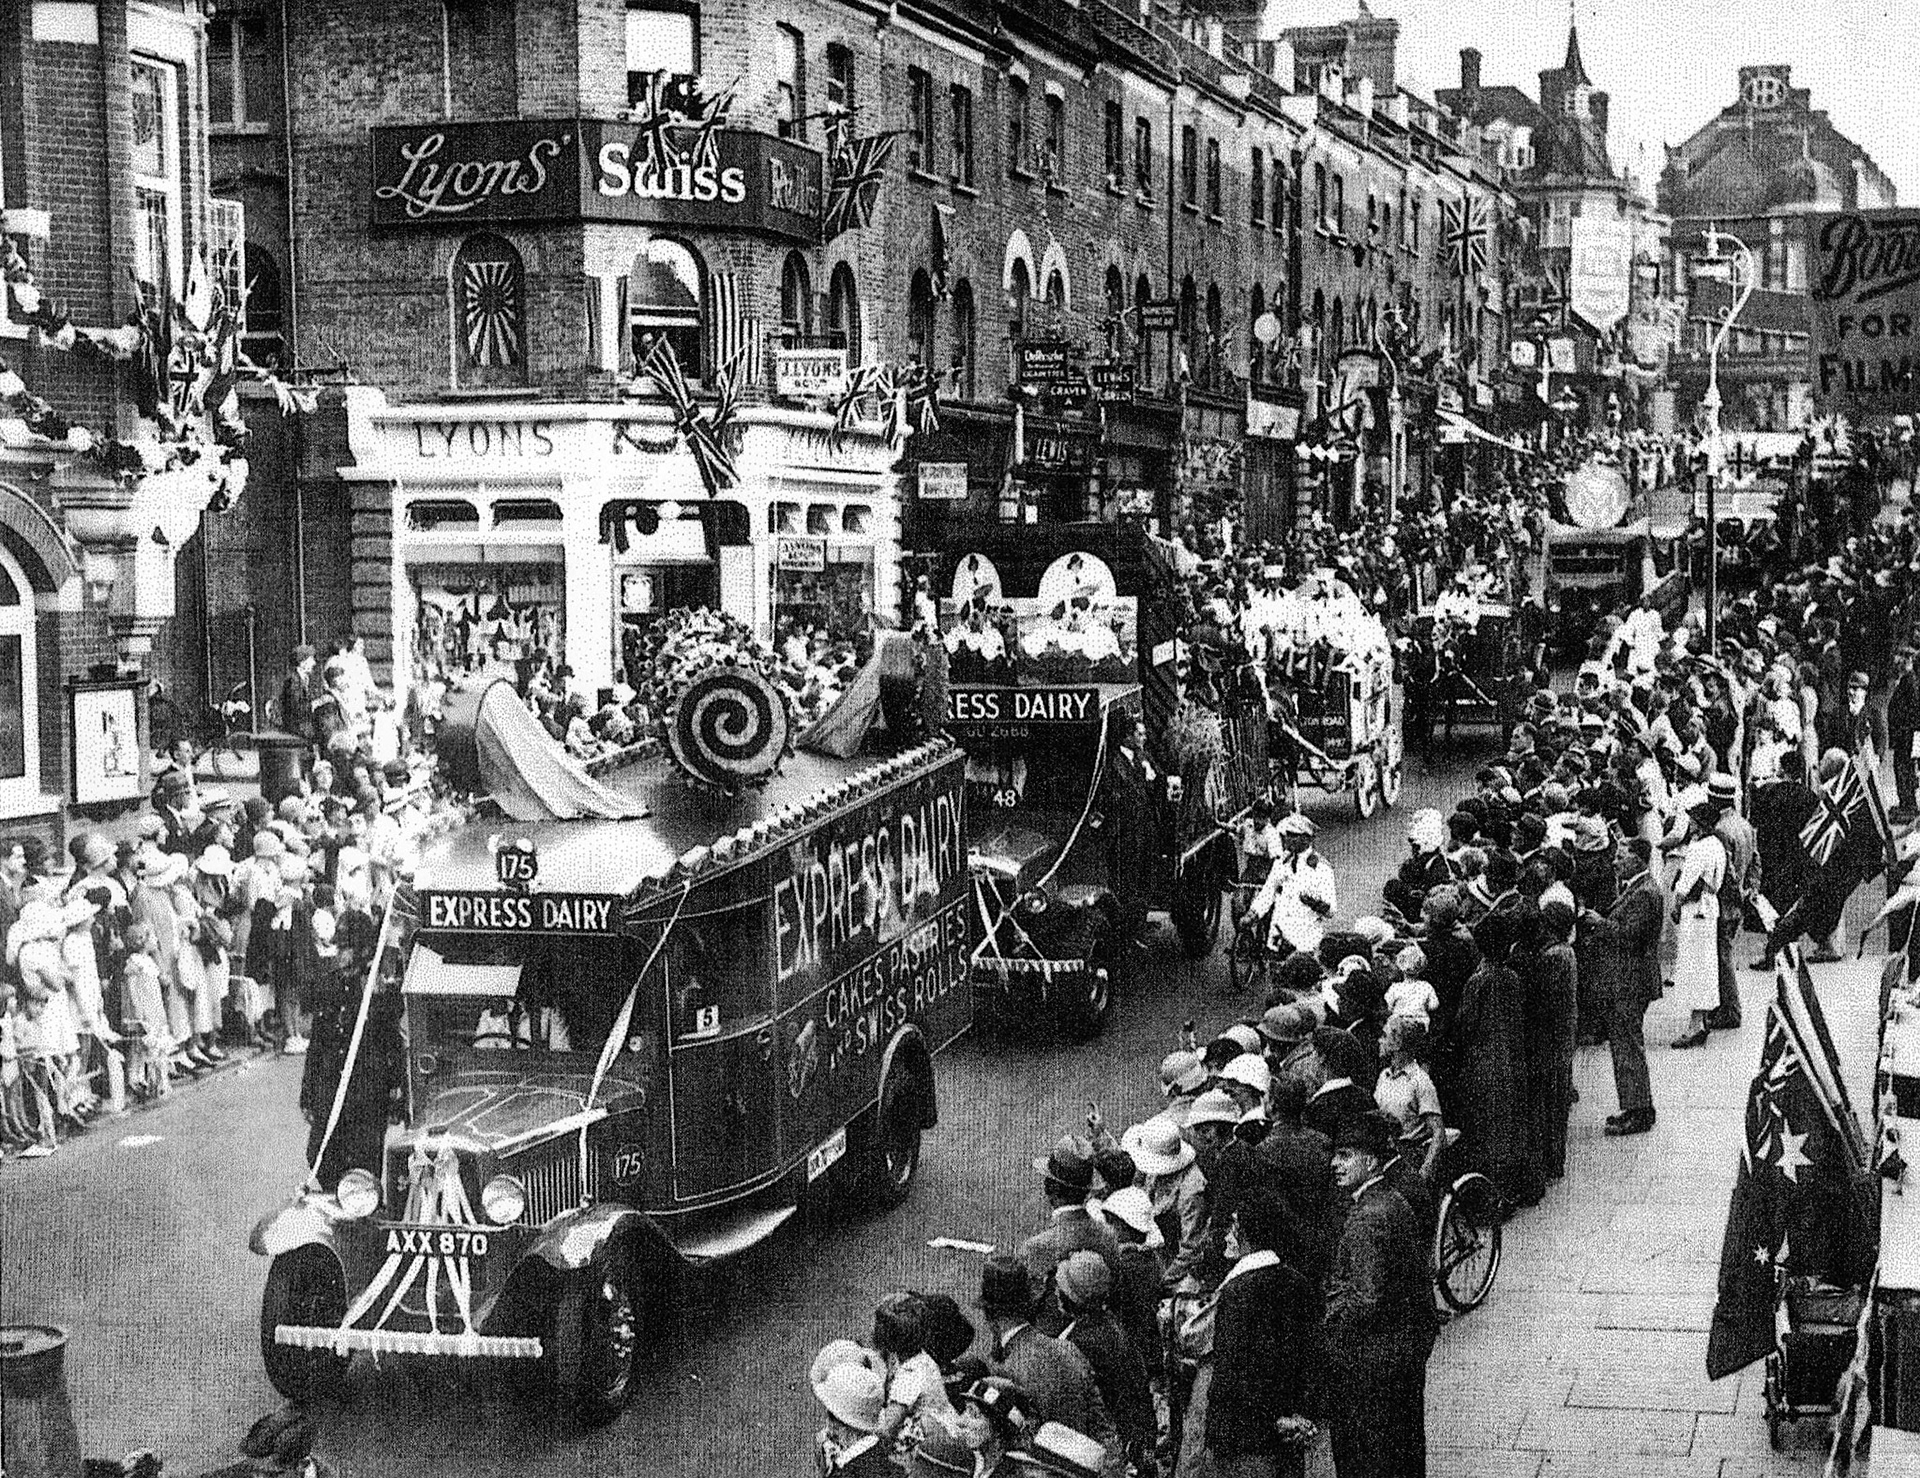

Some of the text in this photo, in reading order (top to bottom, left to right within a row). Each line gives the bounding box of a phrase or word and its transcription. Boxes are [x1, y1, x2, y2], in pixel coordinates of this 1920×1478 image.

[598, 142, 746, 203] Swiss
[1838, 315, 1911, 338] FOR
[1050, 386, 1087, 397] CRAVEN
[411, 421, 554, 457] LYONS
[1014, 692, 1091, 720] DAIRY
[993, 789, 1017, 808] 48
[501, 854, 534, 879] 175
[774, 785, 963, 983] EXPRESS DAIRY
[429, 895, 612, 930] EXPRESS DAIRY
[827, 903, 966, 1028] CAKES PASTRIES
[856, 987, 907, 1055] SWISS
[914, 944, 967, 1012] ROLLS
[703, 1008, 714, 1028] 5
[614, 1153, 642, 1179] 175
[386, 1230, 488, 1255] AXX 870
